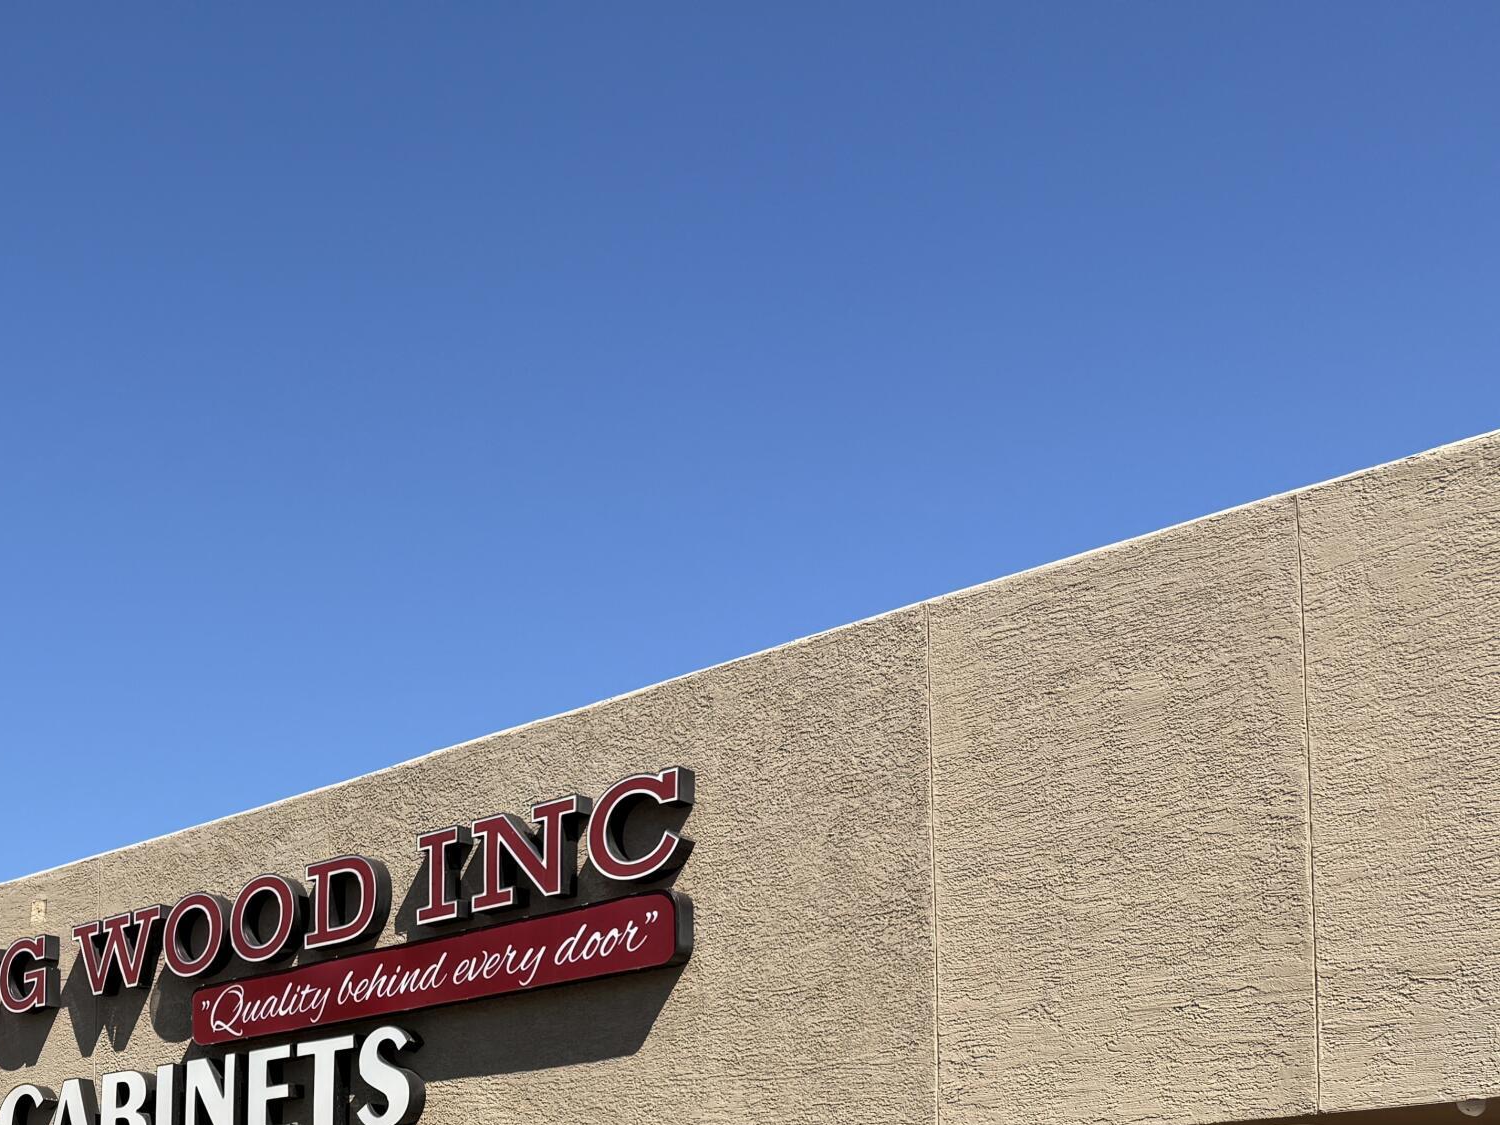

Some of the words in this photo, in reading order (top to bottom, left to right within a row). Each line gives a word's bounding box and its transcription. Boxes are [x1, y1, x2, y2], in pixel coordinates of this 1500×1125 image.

[71, 853, 380, 996] WOOD
[415, 765, 681, 926] INC
[337, 952, 448, 1006] behind
[452, 944, 547, 987] every
